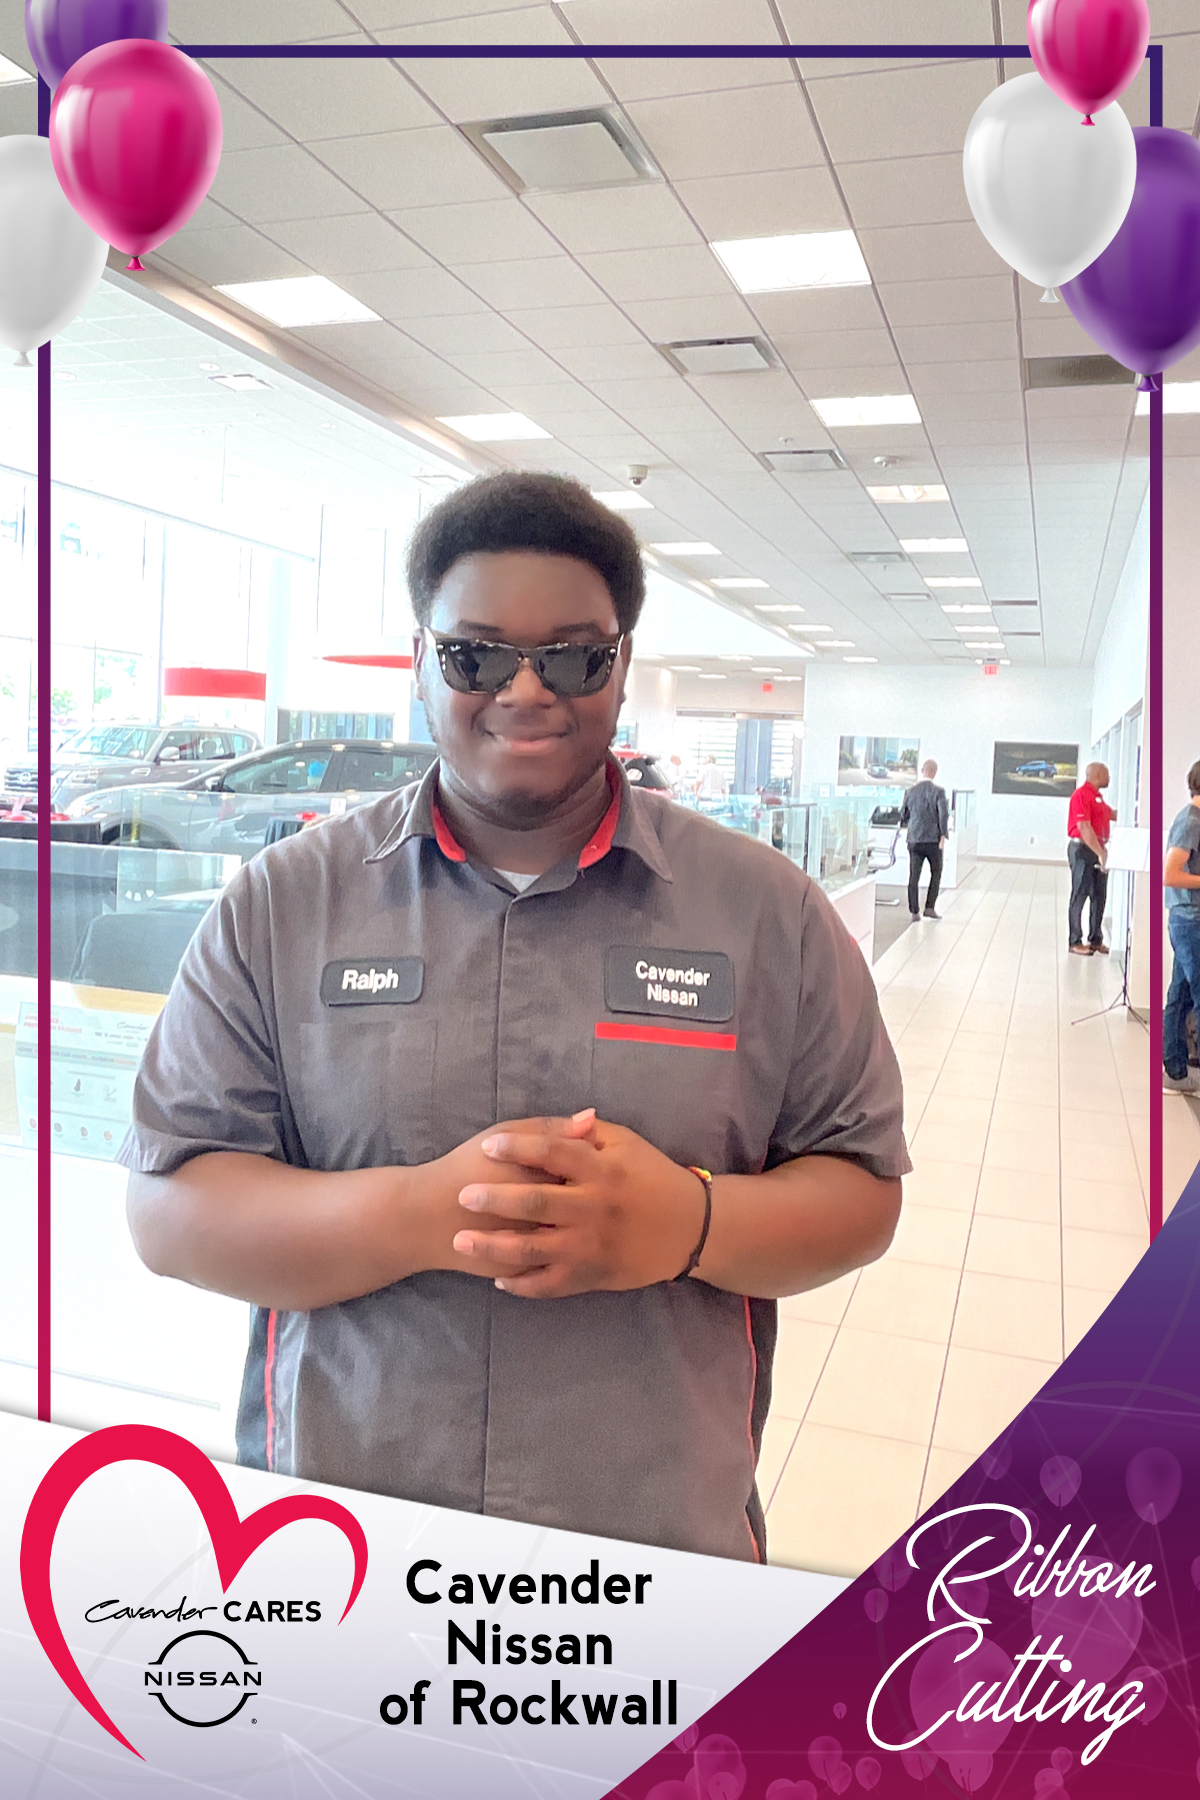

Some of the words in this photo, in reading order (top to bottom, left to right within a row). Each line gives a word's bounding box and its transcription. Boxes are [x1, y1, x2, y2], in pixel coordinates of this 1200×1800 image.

[341, 968, 399, 994] Ralph
[635, 960, 711, 987] Cavender
[646, 984, 699, 1008] Nissan
